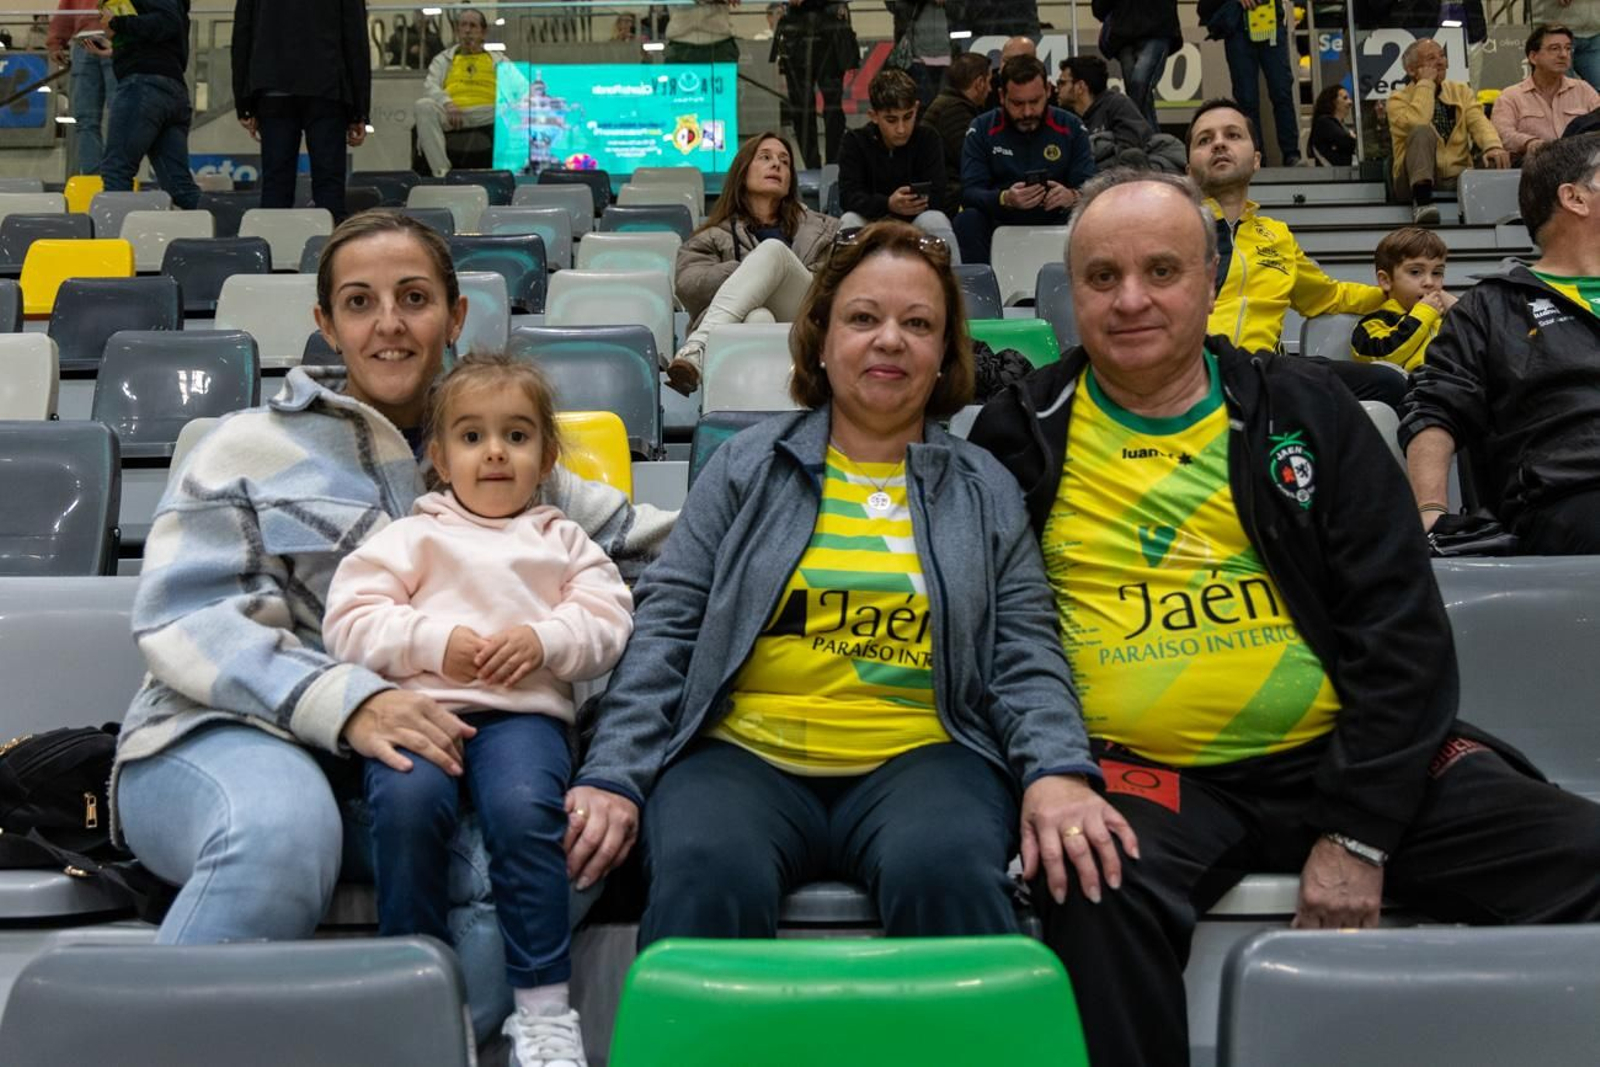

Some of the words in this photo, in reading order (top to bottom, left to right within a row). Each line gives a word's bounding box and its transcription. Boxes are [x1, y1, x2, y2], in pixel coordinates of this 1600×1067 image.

[1122, 448, 1173, 460] luan
[1117, 570, 1280, 641] Jaén
[812, 636, 895, 662] PARAÍSO
[1099, 635, 1200, 666] PARAÍSO
[1206, 623, 1299, 653] INTERIO
